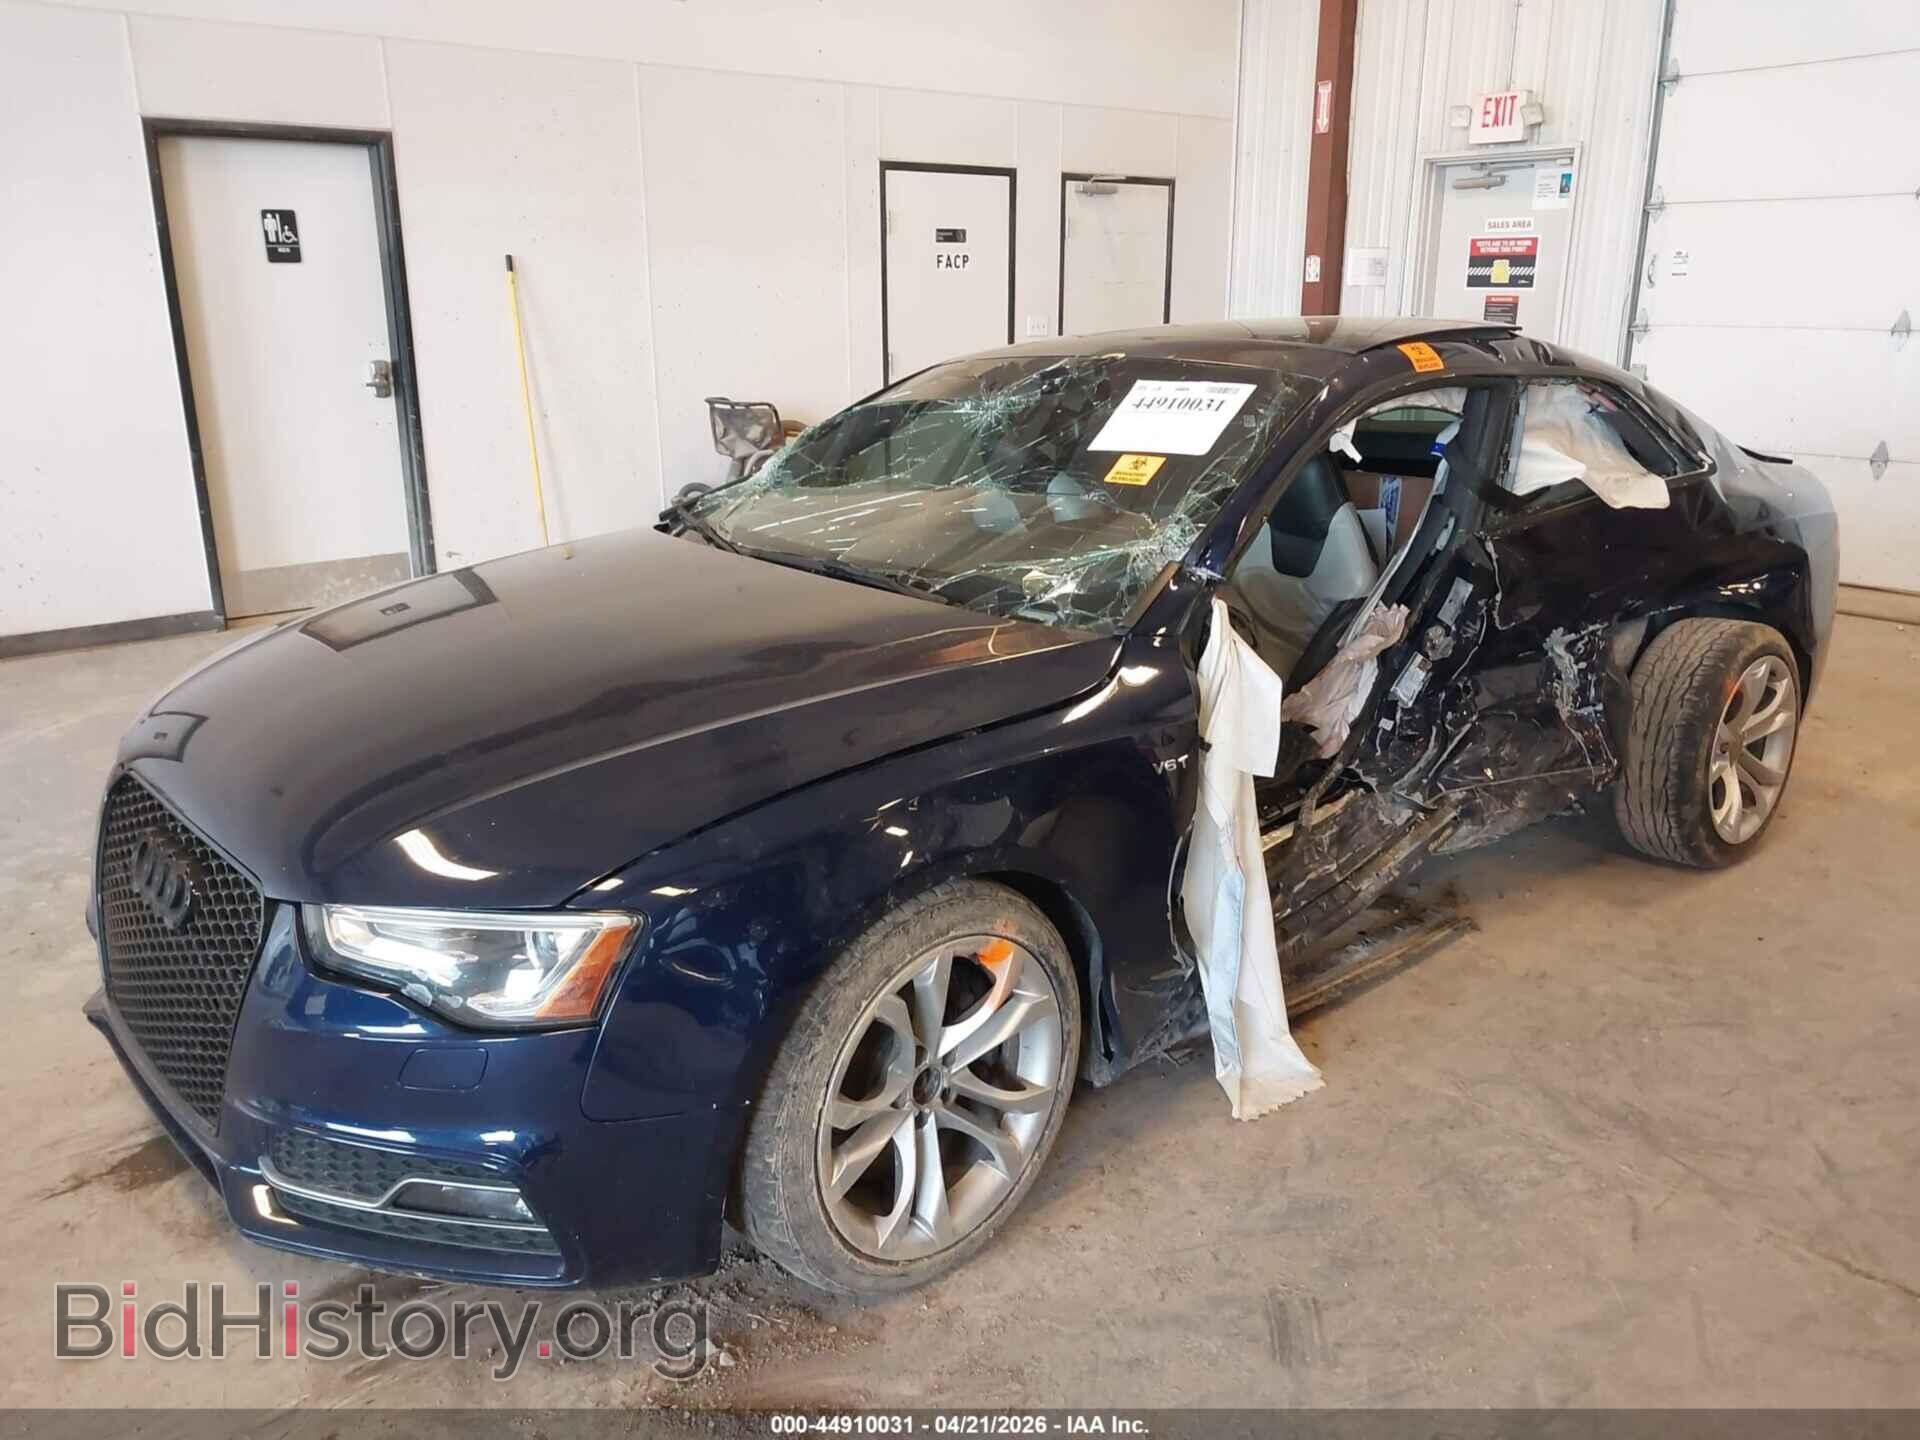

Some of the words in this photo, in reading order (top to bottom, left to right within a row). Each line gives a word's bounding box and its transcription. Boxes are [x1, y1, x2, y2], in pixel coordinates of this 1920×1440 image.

[1481, 95, 1518, 128] EXIT
[1487, 220, 1510, 229] SALES
[1512, 219, 1532, 228] AREA
[937, 254, 970, 269] FACP
[1132, 396, 1226, 412] 44910031
[1152, 753, 1190, 776] V6T
